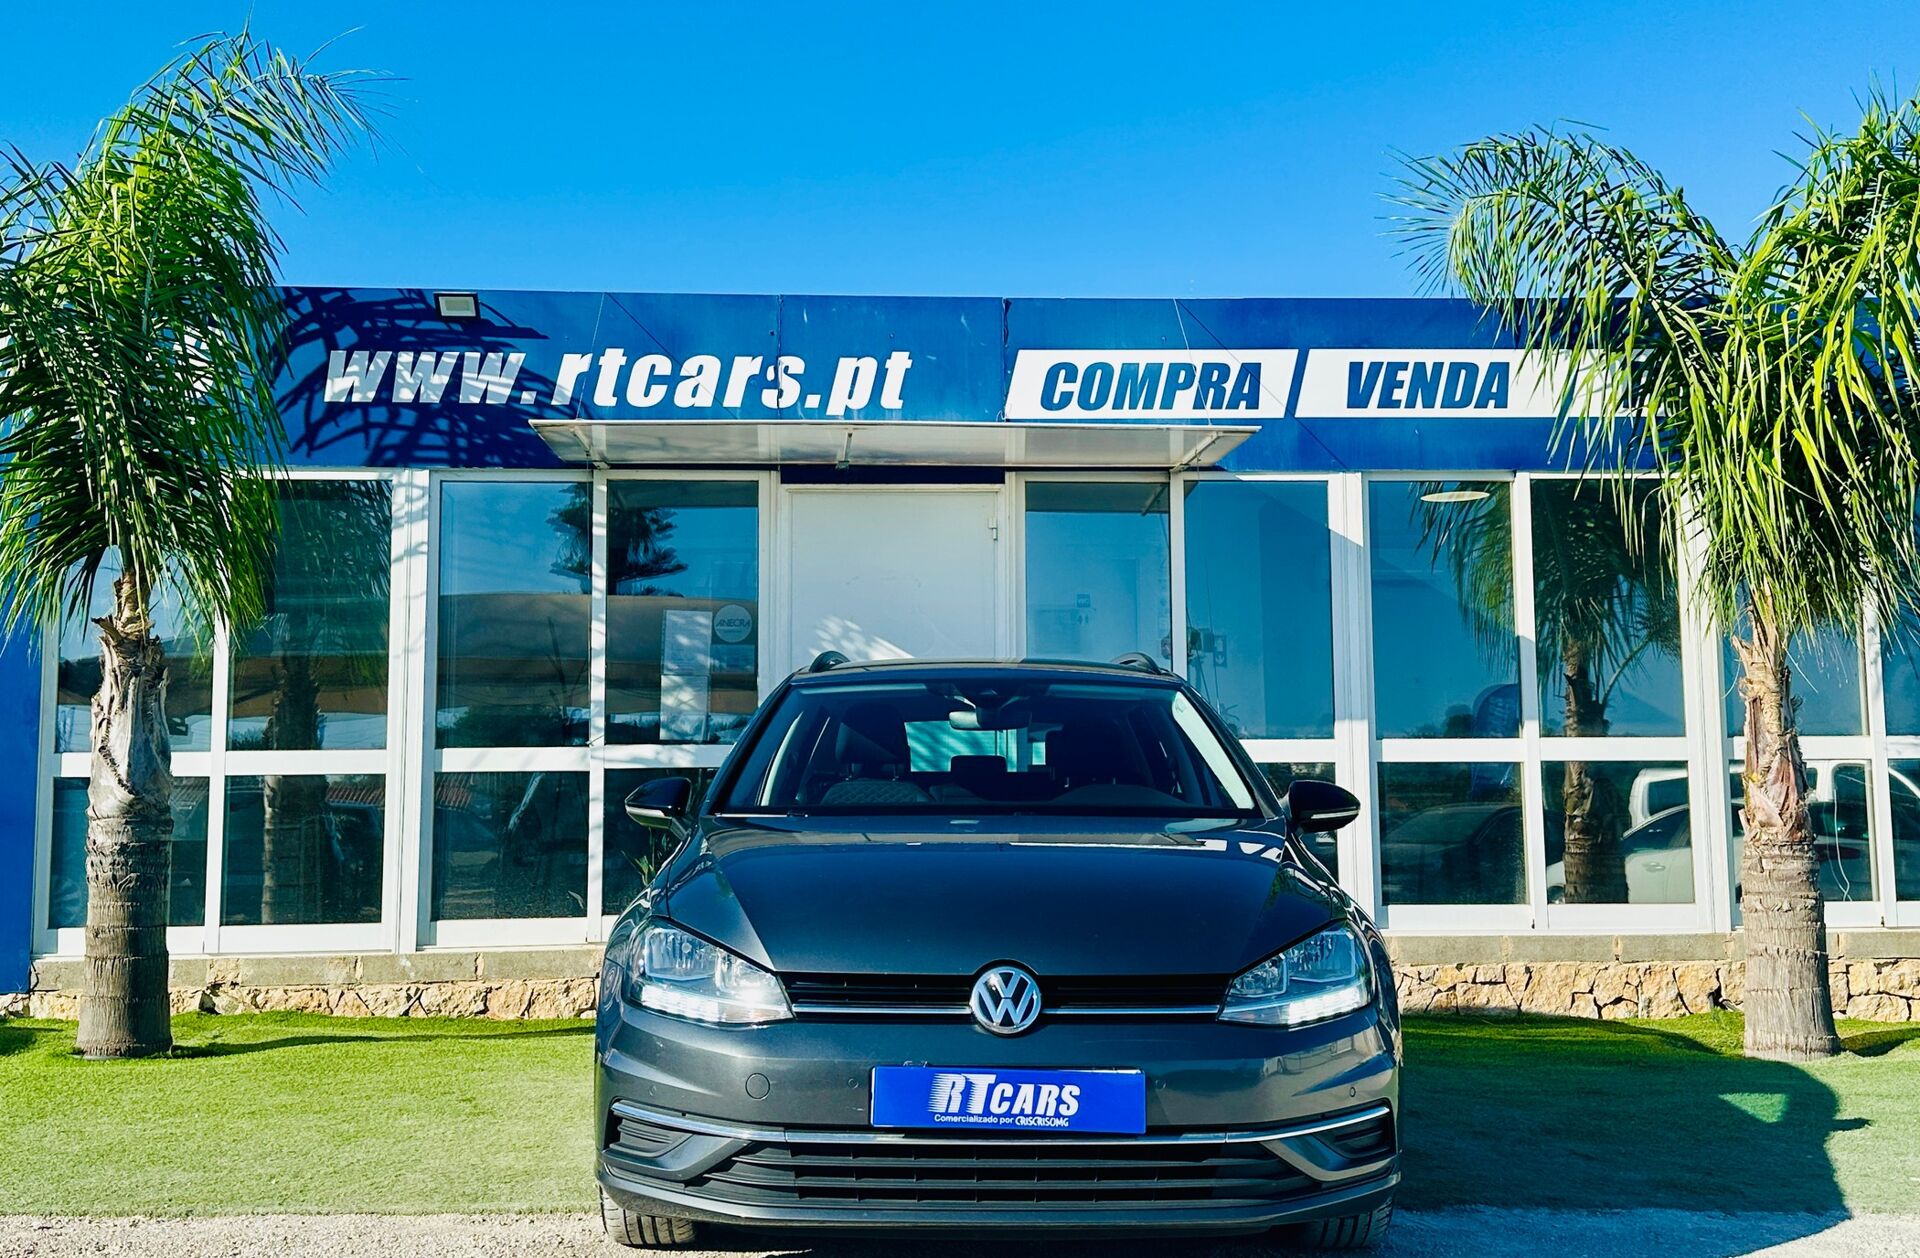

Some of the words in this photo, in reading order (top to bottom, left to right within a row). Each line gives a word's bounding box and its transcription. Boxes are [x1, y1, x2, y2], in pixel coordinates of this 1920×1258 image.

[323, 347, 914, 416] www.rtcars.pt
[1040, 361, 1262, 412] COMPRA
[1346, 361, 1511, 410] VENDA
[934, 1114, 998, 1124] Comercializado
[999, 1117, 1014, 1125] por
